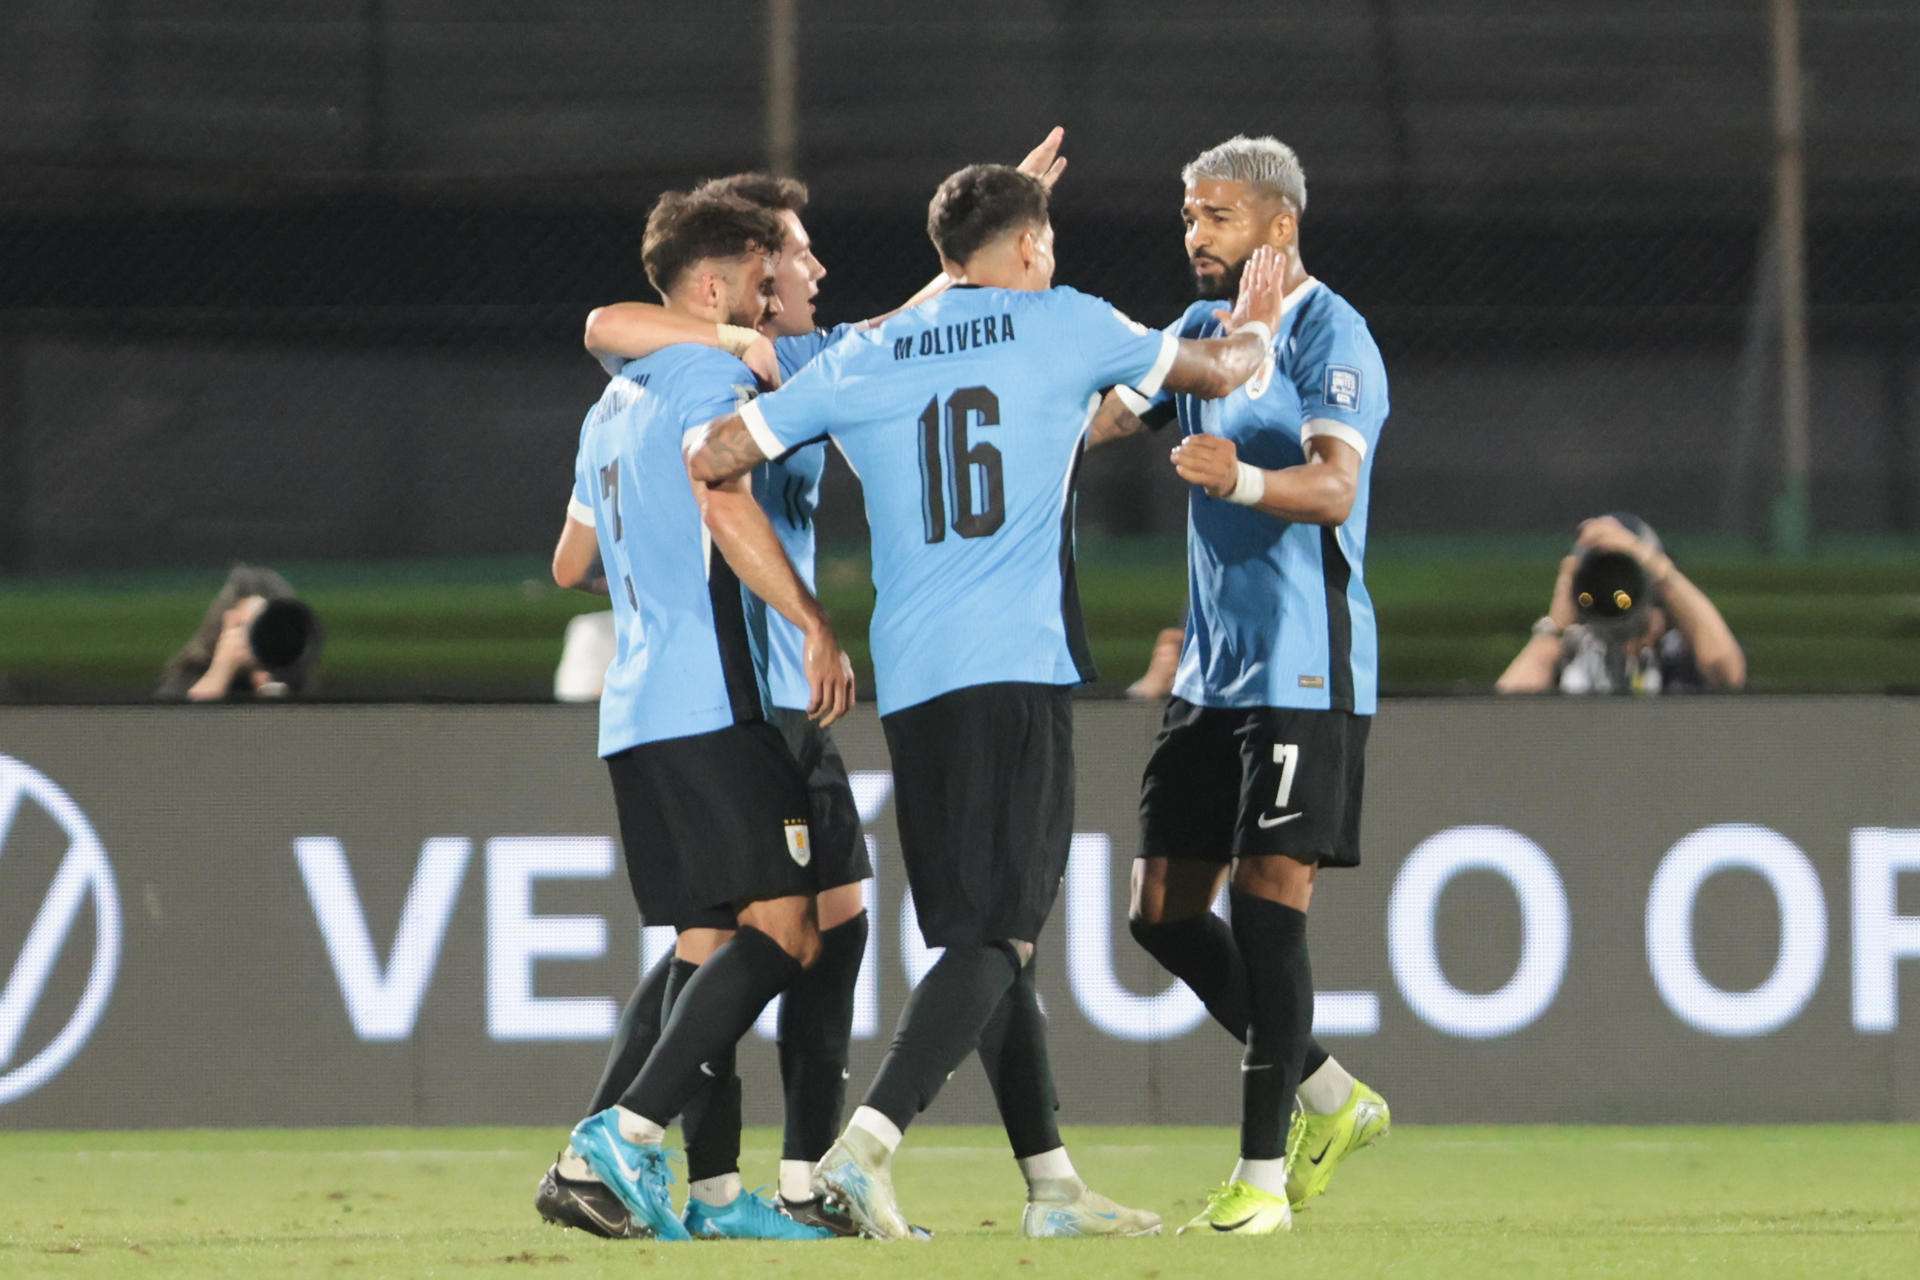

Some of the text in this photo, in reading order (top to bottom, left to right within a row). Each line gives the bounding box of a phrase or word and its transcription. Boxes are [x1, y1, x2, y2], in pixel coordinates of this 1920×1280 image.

[917, 384, 1006, 545] 16
[1272, 743, 1299, 808] 7
[293, 768, 1573, 1041] VEÍUO
